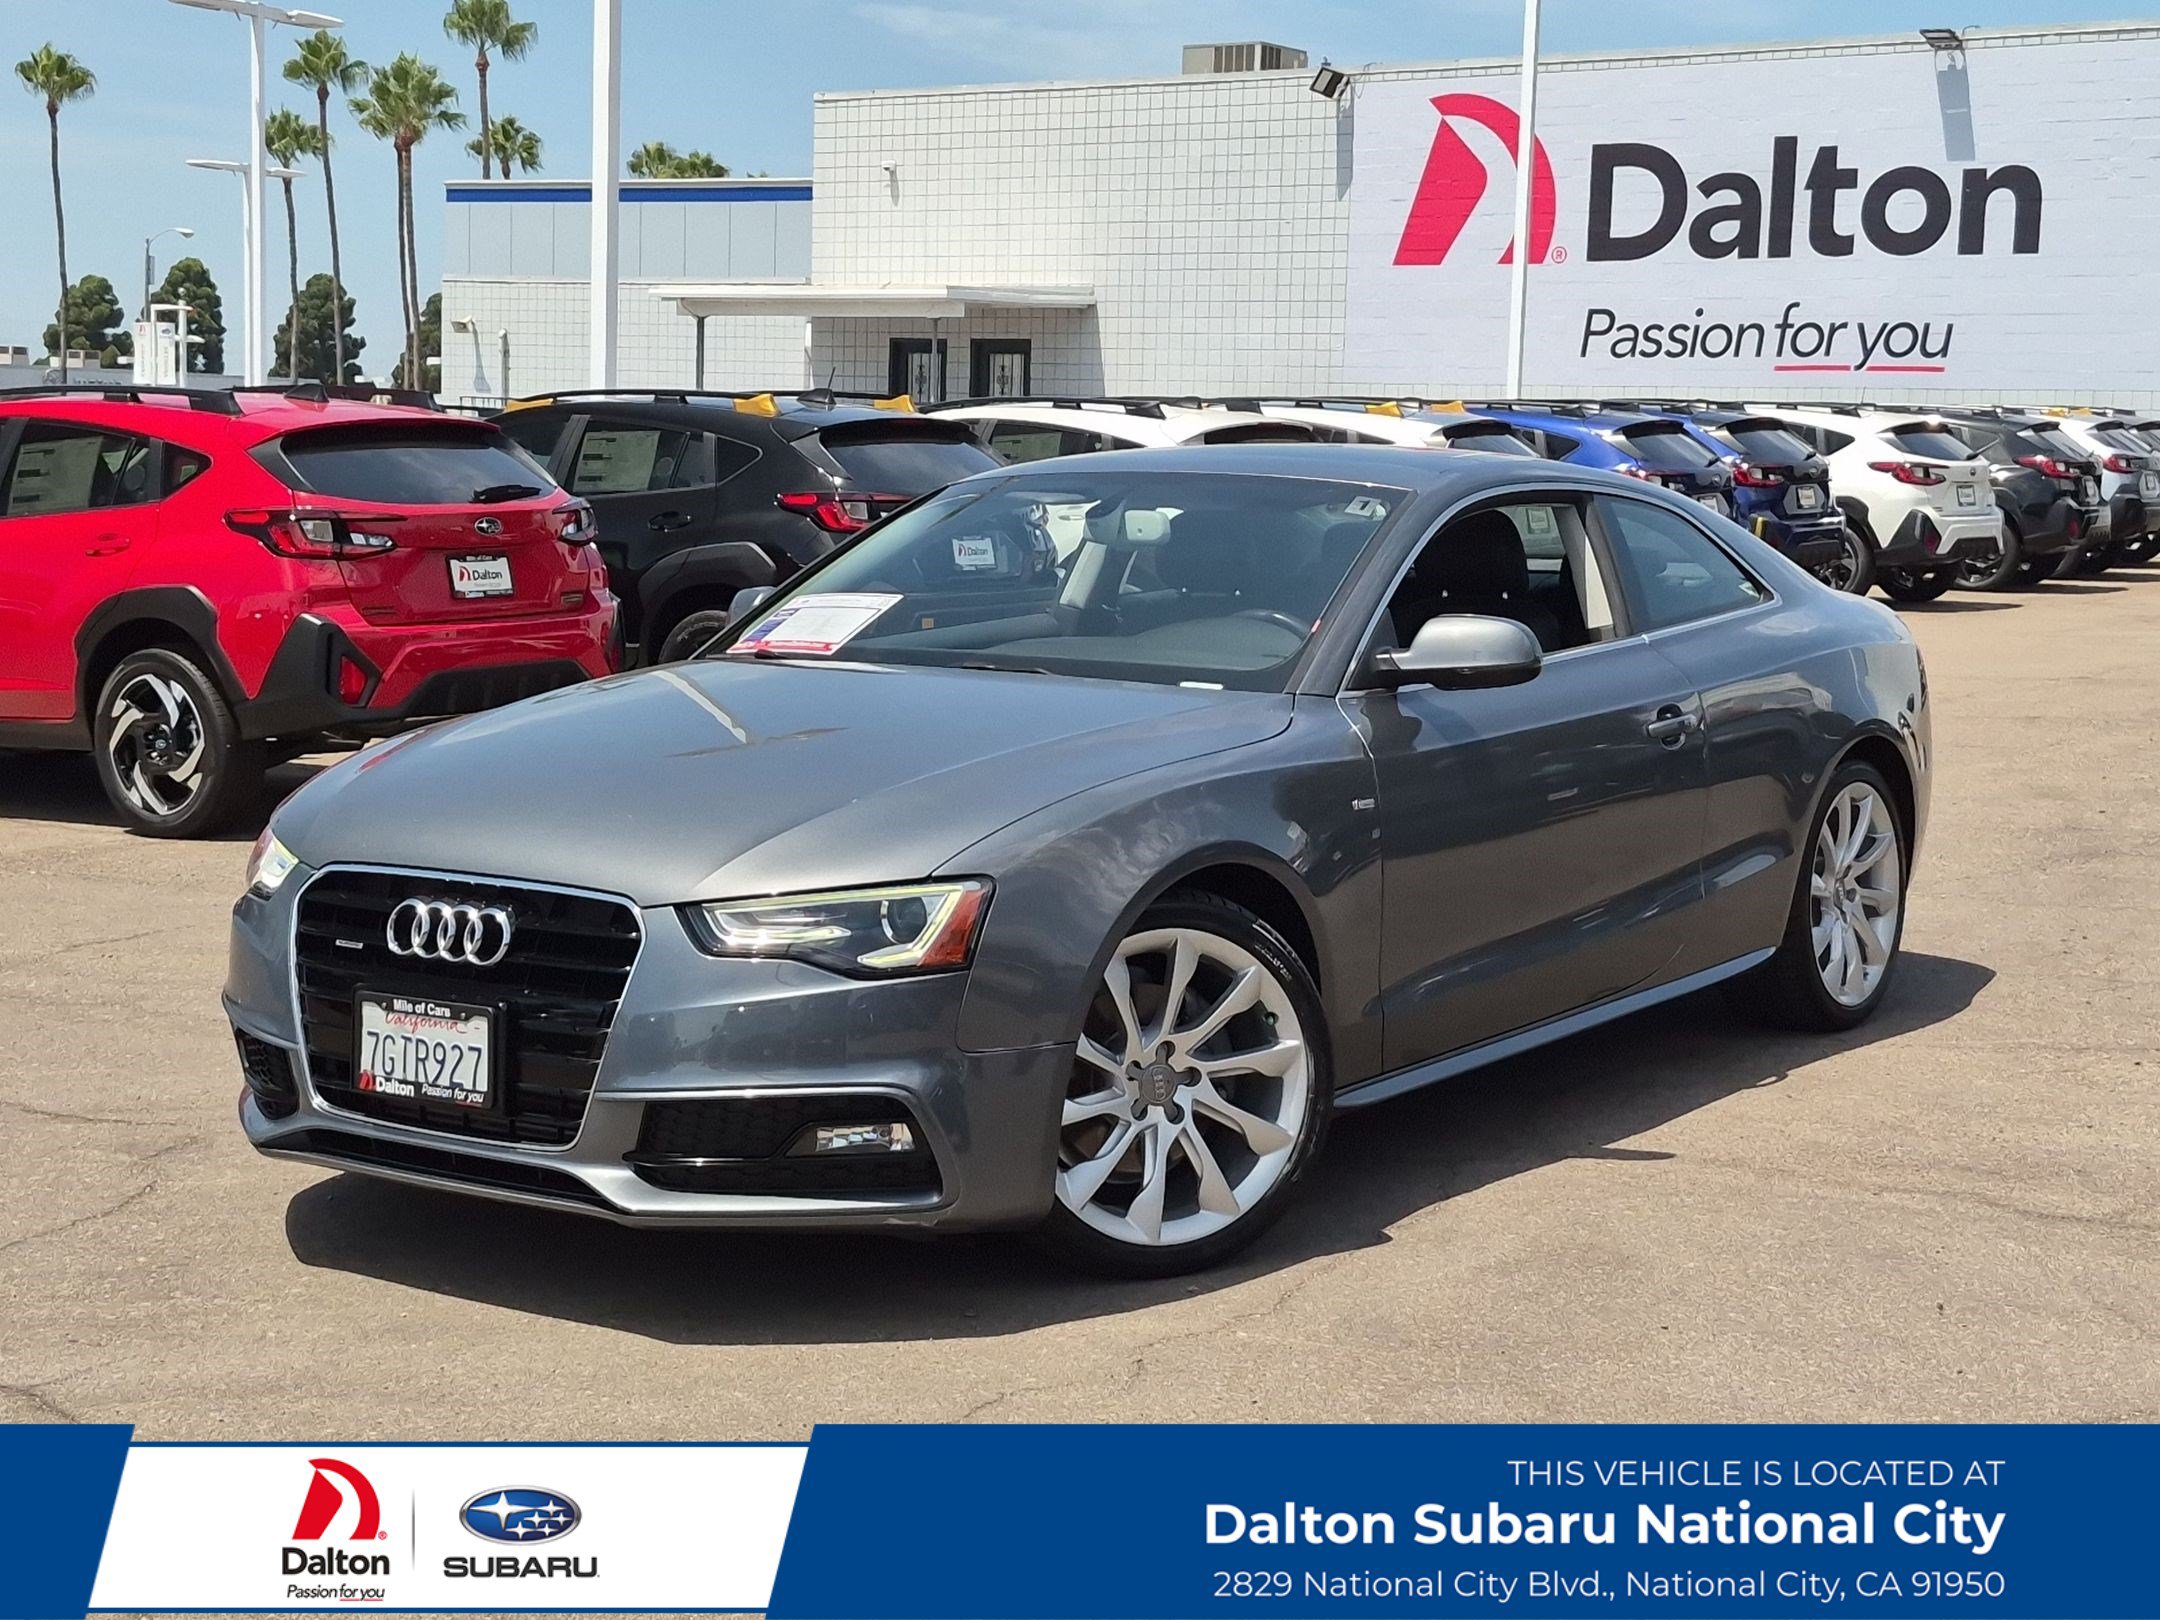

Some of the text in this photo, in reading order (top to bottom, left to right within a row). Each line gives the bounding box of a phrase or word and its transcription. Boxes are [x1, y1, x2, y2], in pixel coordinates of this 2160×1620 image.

[1587, 136, 2043, 262] Dalton
[1579, 301, 1955, 372] Passion for you
[472, 568, 503, 581] Dalton
[393, 998, 451, 1017] Mile of Cars
[384, 1011, 467, 1034] California
[367, 1030, 482, 1091] 7GTR927
[375, 1076, 415, 1098] Dalton
[421, 1083, 484, 1103] Passion for you
